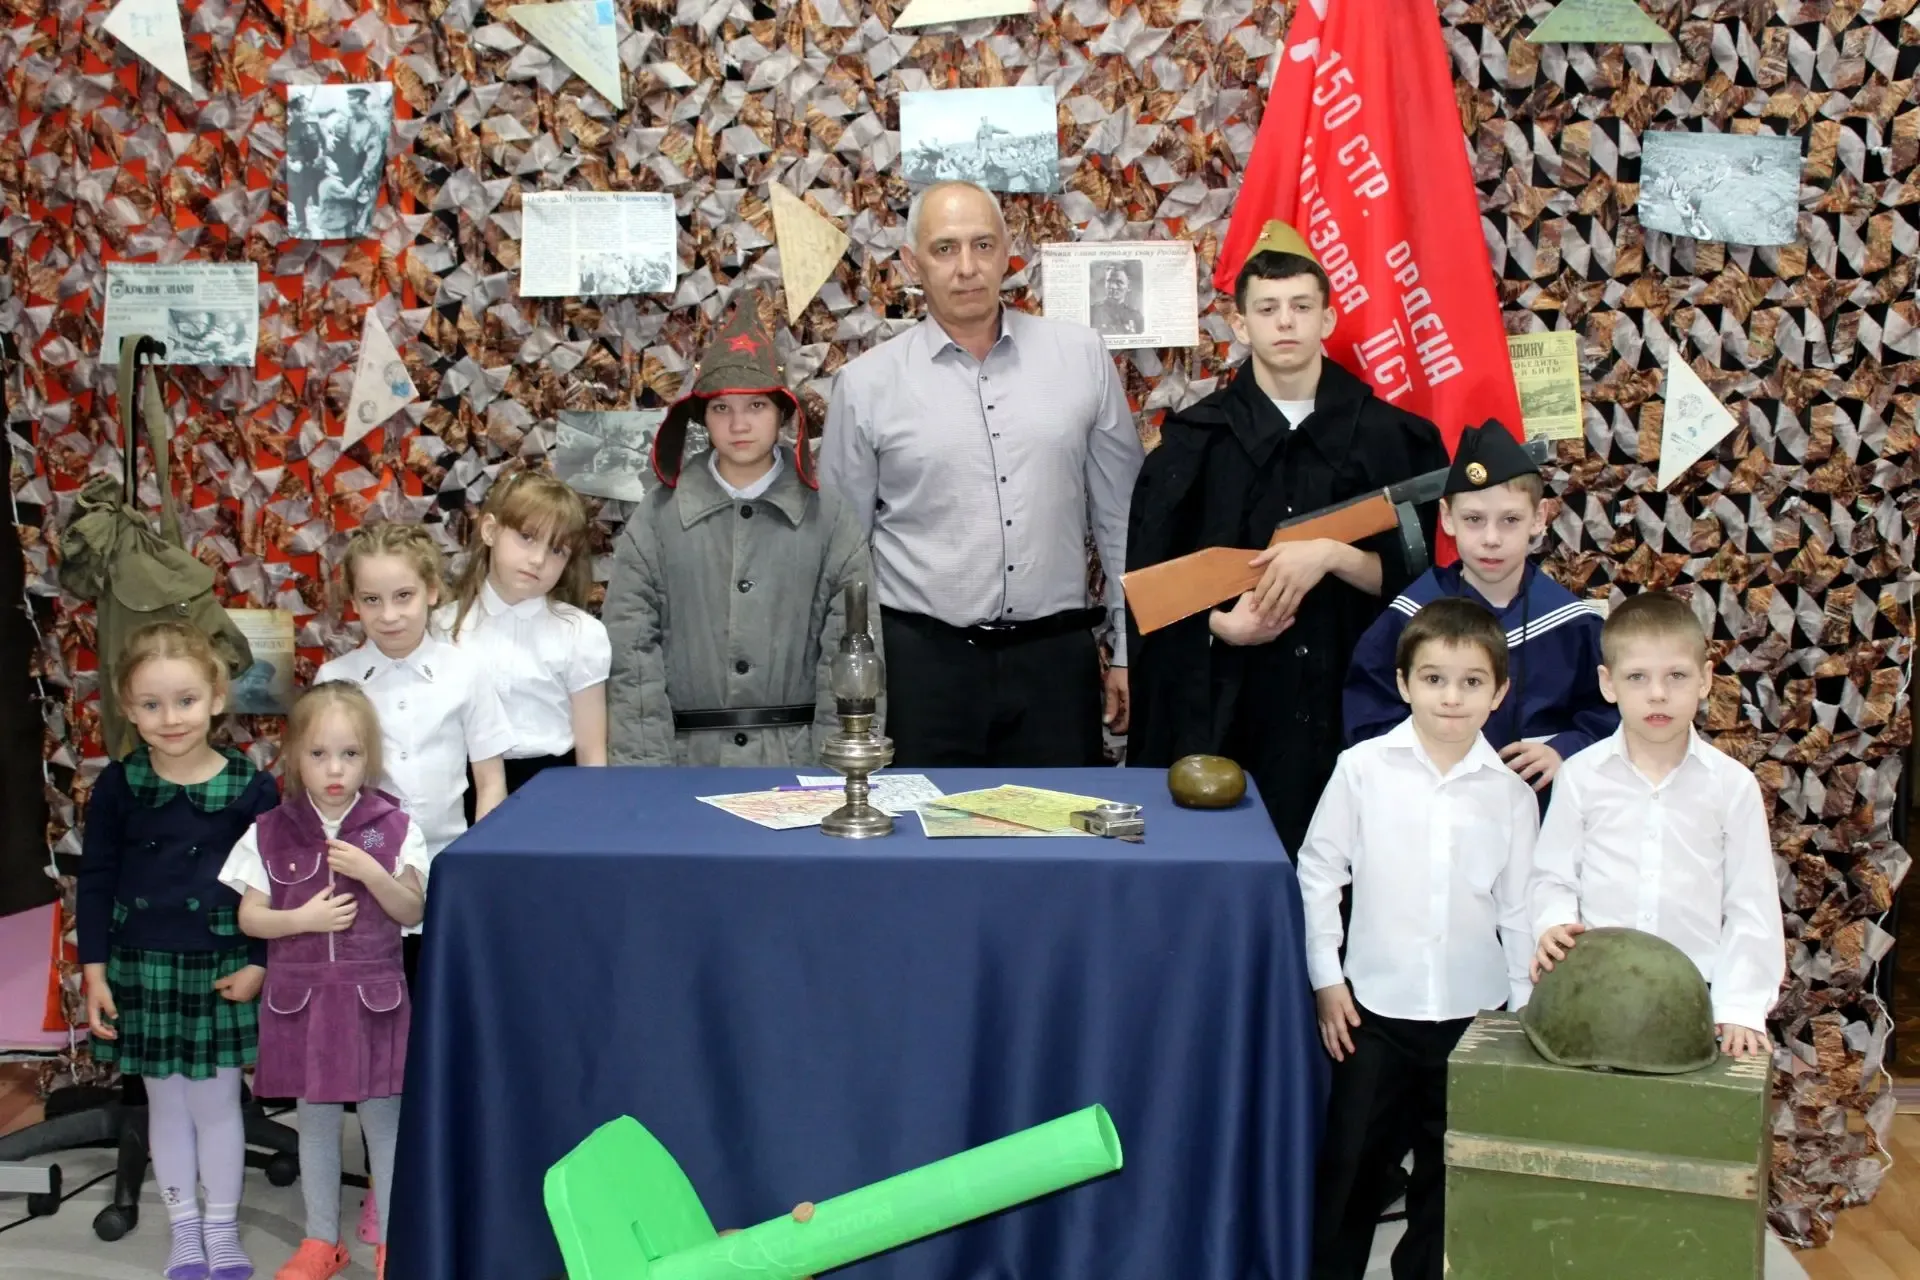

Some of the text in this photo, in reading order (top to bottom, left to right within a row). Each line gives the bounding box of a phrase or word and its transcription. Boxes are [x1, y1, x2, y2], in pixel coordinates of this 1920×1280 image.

[1312, 49, 1464, 388] 150 СТР. ОРДЕНА
